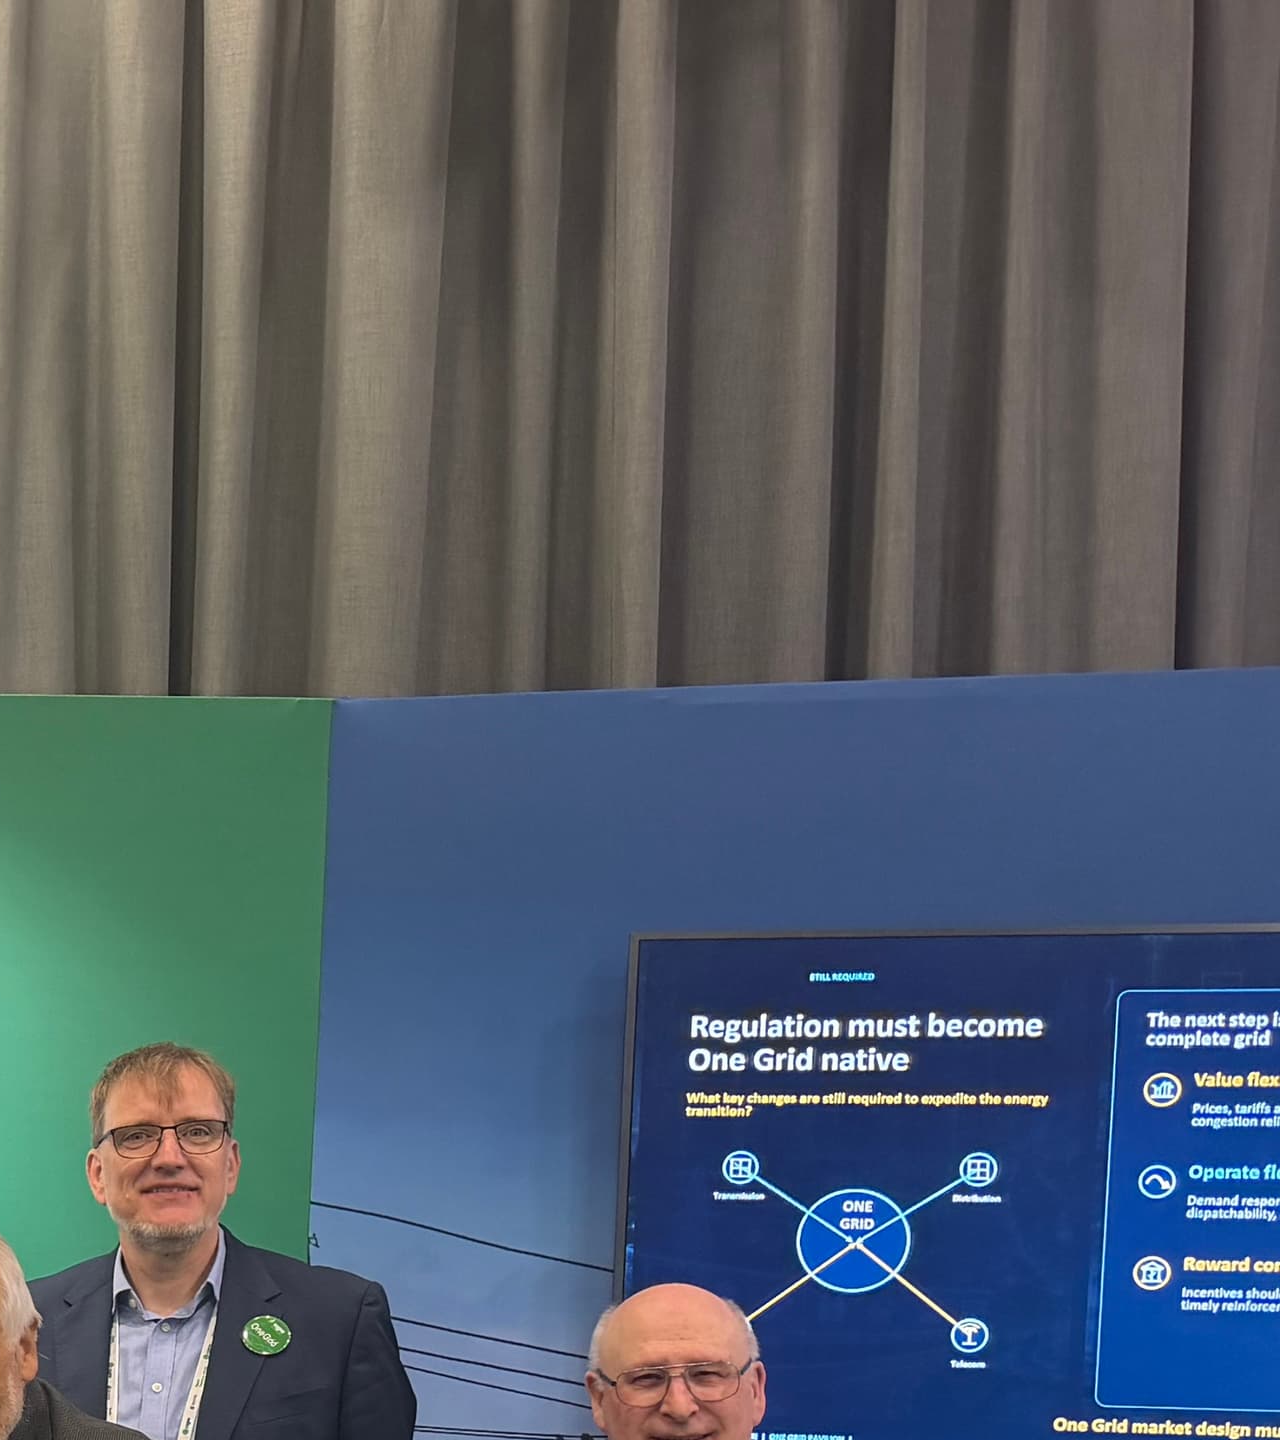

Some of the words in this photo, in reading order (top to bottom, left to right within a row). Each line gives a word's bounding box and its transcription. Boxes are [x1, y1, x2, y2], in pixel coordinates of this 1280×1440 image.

[690, 1013, 841, 1043] Regulation
[848, 1014, 921, 1038] must
[927, 1012, 1044, 1038] become
[1146, 1011, 1181, 1028] The
[1185, 1013, 1226, 1028] next
[1229, 1011, 1269, 1030] step
[1145, 1030, 1231, 1049] complete
[1233, 1029, 1272, 1050] grid
[688, 1048, 746, 1072] One
[753, 1046, 814, 1071] Grid
[821, 1047, 911, 1071] native
[1193, 1071, 1244, 1088] Value
[686, 1092, 721, 1104] What
[723, 1092, 746, 1106] key
[747, 1092, 798, 1107] changes
[799, 1094, 820, 1104] are
[822, 1092, 846, 1104] still
[848, 1092, 902, 1107] required
[904, 1093, 919, 1104] to
[921, 1092, 977, 1107] expedite
[979, 1092, 1001, 1104] the
[1003, 1094, 1049, 1107] energy
[685, 1105, 753, 1117] transition?
[1192, 1102, 1233, 1116] Prices,
[1235, 1101, 1271, 1114] tariffs
[1191, 1116, 1258, 1130] congestion
[1188, 1164, 1260, 1182] Operate
[842, 1201, 873, 1213] ONE
[1186, 1194, 1240, 1206] Demand
[1185, 1206, 1277, 1221] dispatchability,
[840, 1218, 875, 1230] GRID
[1183, 1256, 1251, 1272] Reward
[1181, 1286, 1244, 1299] Incentives
[1180, 1299, 1220, 1314] timely
[1053, 1417, 1088, 1433] One
[1091, 1417, 1128, 1434] Grid
[1131, 1419, 1192, 1436] market
[1195, 1420, 1251, 1440] design
